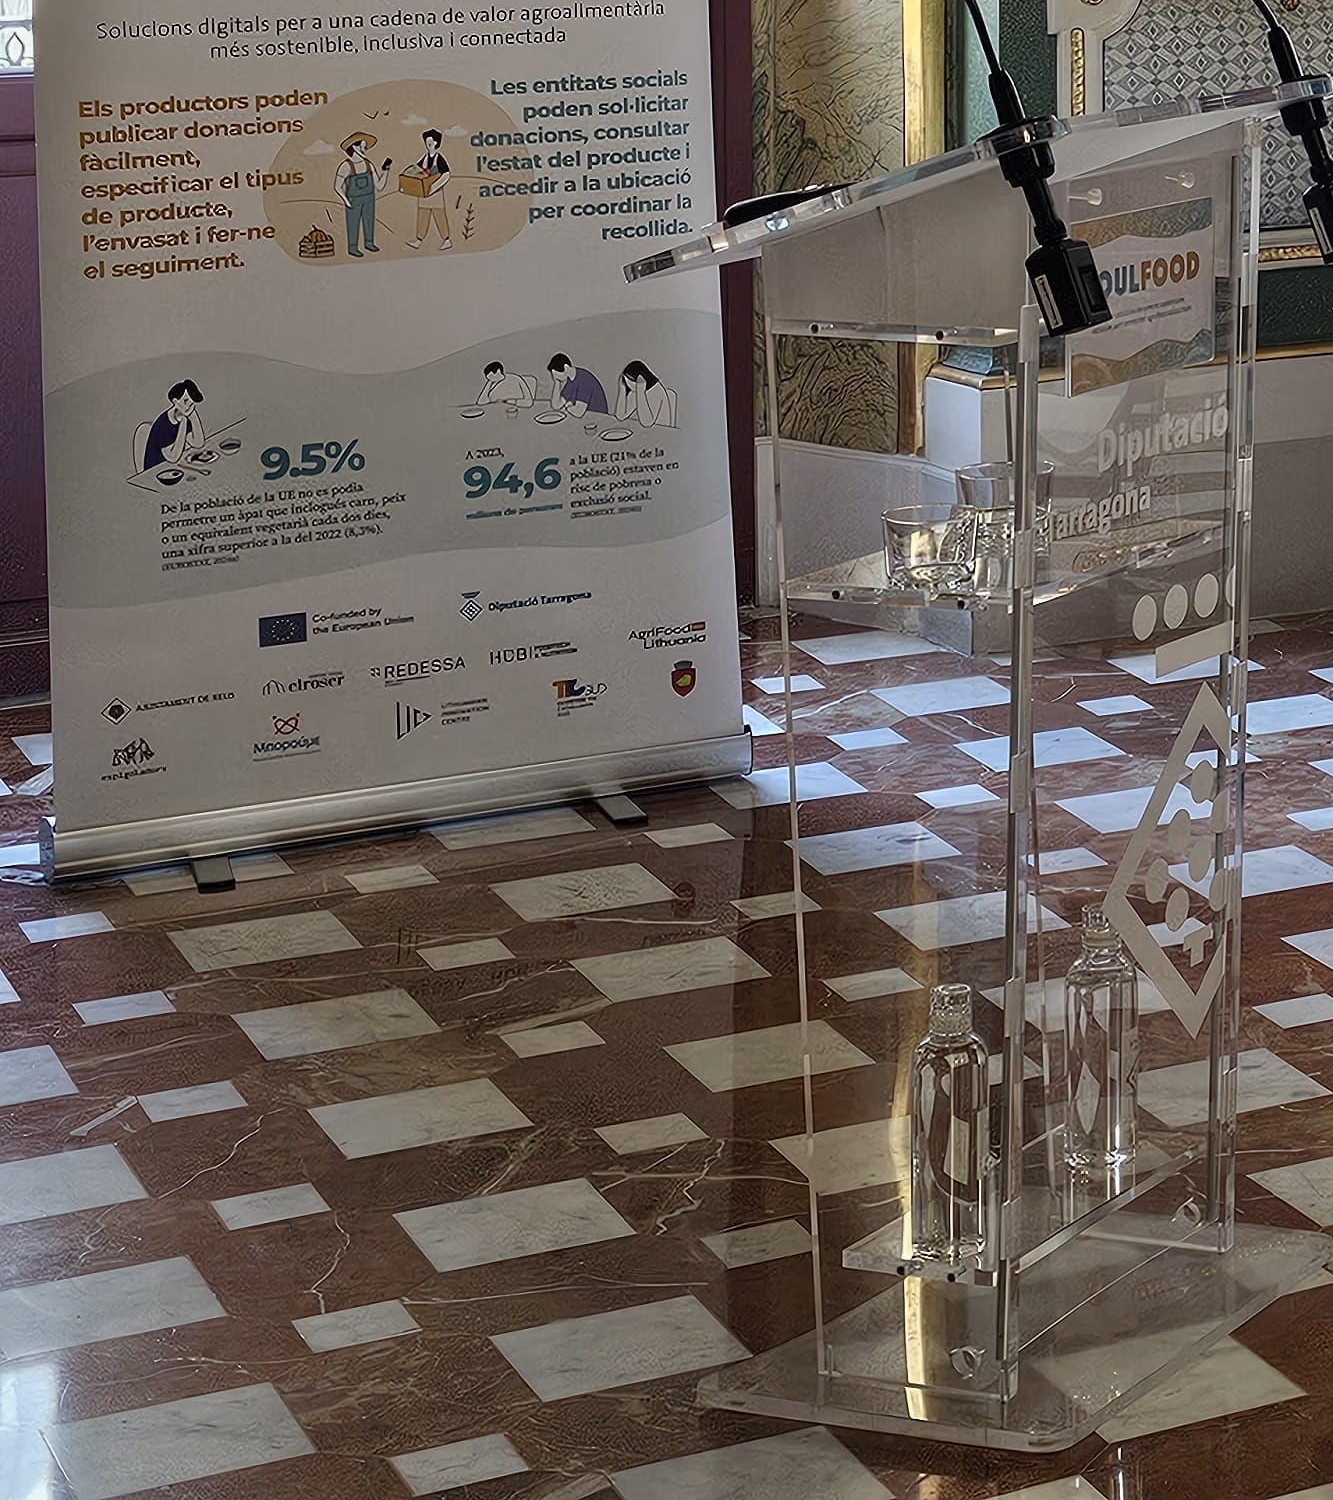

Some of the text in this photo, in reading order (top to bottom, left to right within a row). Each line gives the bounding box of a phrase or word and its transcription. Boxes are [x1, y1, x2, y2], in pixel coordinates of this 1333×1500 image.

[97, 0, 665, 41] Solucions digitals per a una cadena de valor agroalimentària
[210, 25, 566, 59] més sostenible, inclusiva i connectada
[490, 70, 688, 95] Les entitats socials
[78, 89, 328, 120] Els productors poden
[523, 94, 688, 123] poden sol·licitar
[80, 117, 304, 149] publicar donacions
[470, 120, 690, 147] donacions, consultar
[80, 150, 201, 171] fàcilment,
[550, 150, 580, 168] del
[587, 144, 680, 169] producte
[685, 142, 690, 159] i
[81, 169, 304, 201] especificar el tipus
[479, 167, 691, 197] accedir a la ubicació
[82, 202, 233, 227] de producte,
[528, 193, 692, 224] per coordinar la
[195, 227, 201, 245] i
[208, 223, 276, 244] fer-ne
[602, 219, 693, 241] recollida.
[83, 252, 245, 280] el seguiment.
[1099, 251, 1200, 298] OULFOOD
[1098, 392, 1229, 477] Diputació
[260, 439, 366, 481] 9.5%
[463, 457, 561, 498] 94,6
[161, 504, 178, 515] De
[180, 502, 190, 512] la
[194, 495, 244, 513] població
[264, 492, 274, 502] la
[278, 490, 296, 501] UE
[299, 489, 313, 498] no
[161, 548, 185, 560] una
[218, 535, 268, 554] superior
[282, 535, 292, 546] la
[295, 532, 312, 544] del
[315, 528, 342, 541] 2022
[384, 656, 466, 679] REDESSA
